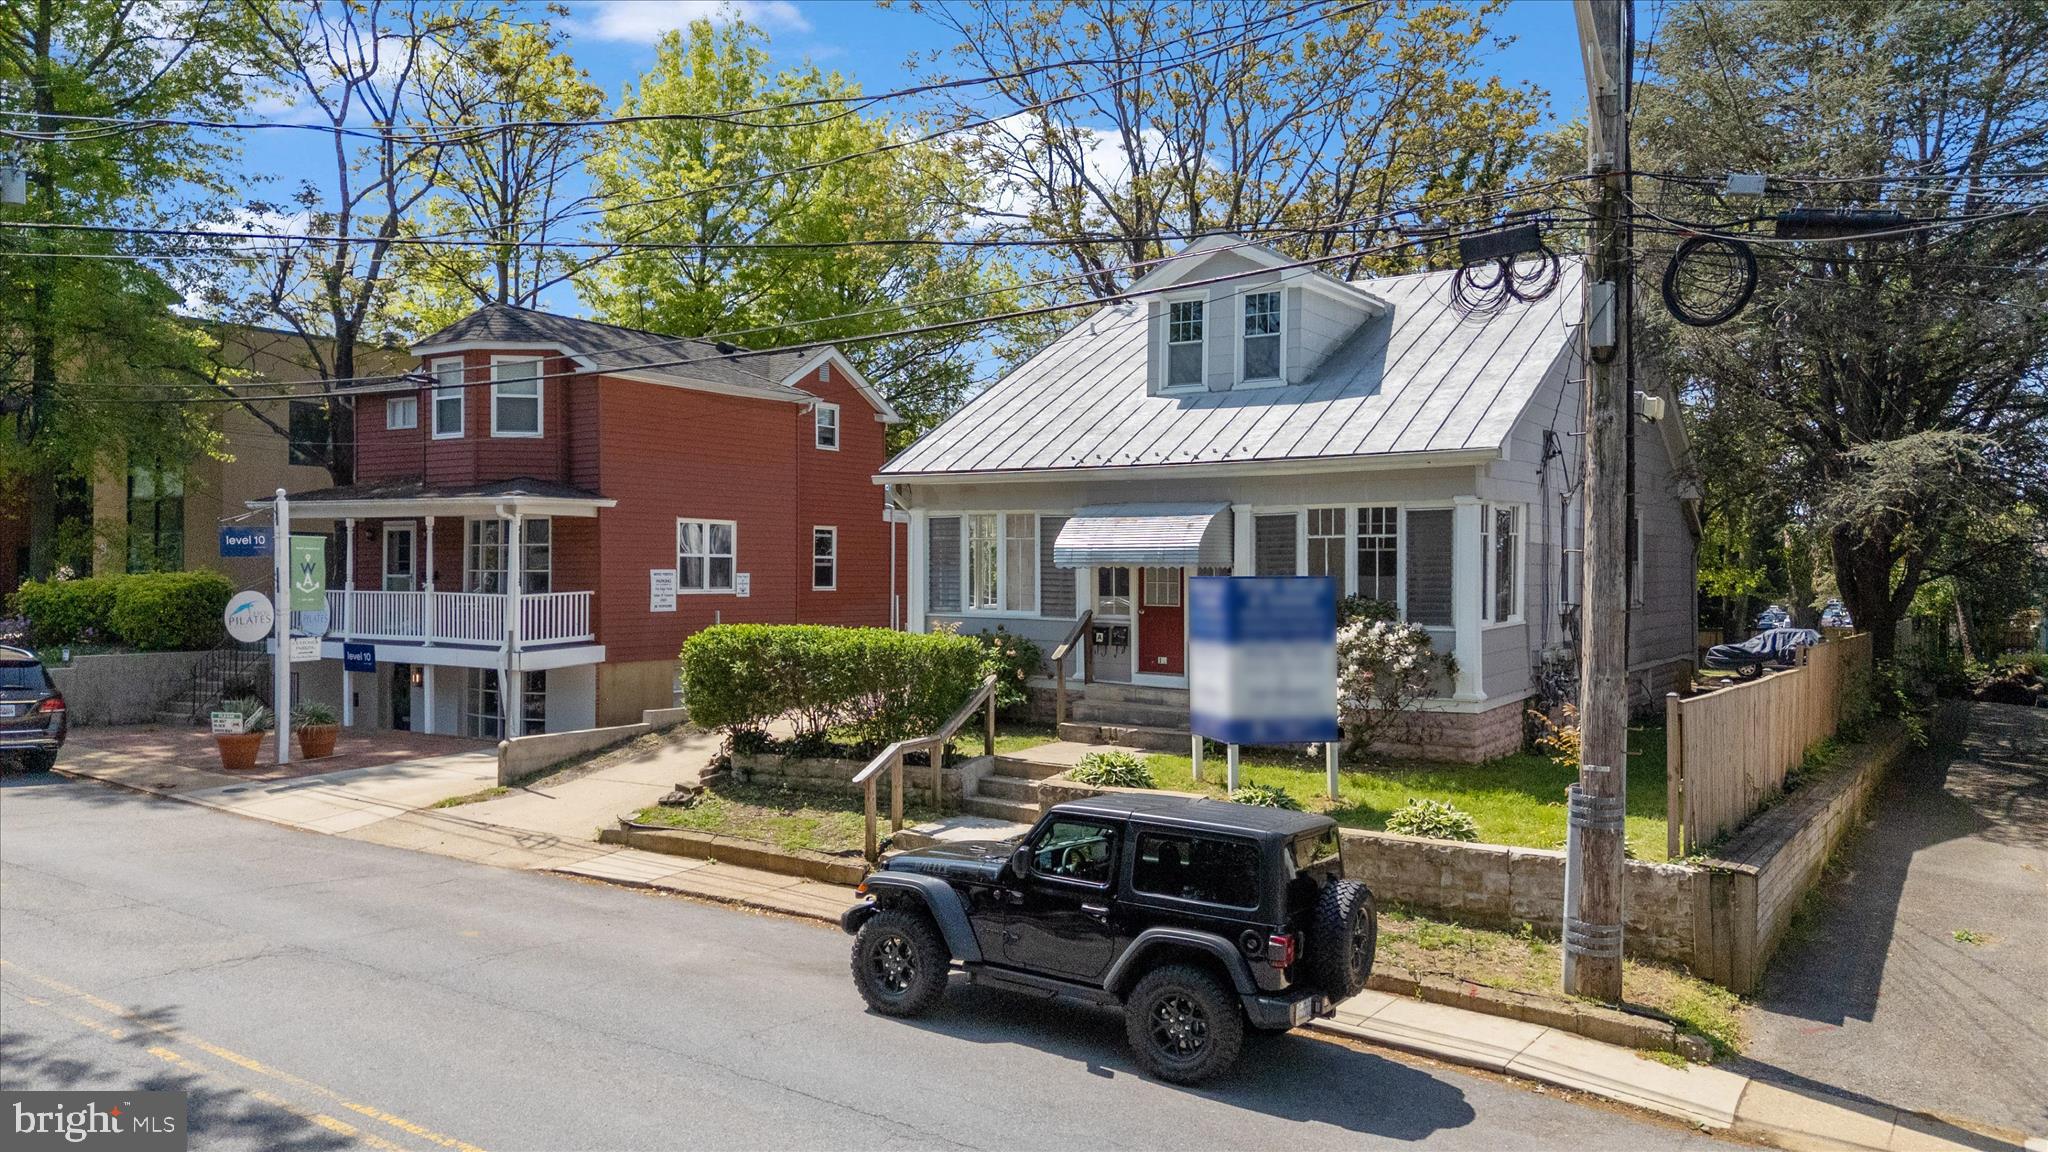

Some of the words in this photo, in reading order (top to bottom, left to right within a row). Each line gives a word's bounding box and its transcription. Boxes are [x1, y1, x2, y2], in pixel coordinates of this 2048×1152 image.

[226, 535, 252, 545] level
[253, 535, 266, 545] 10
[228, 615, 272, 626] PILATES
[346, 651, 363, 661] level
[363, 652, 371, 662] 10
